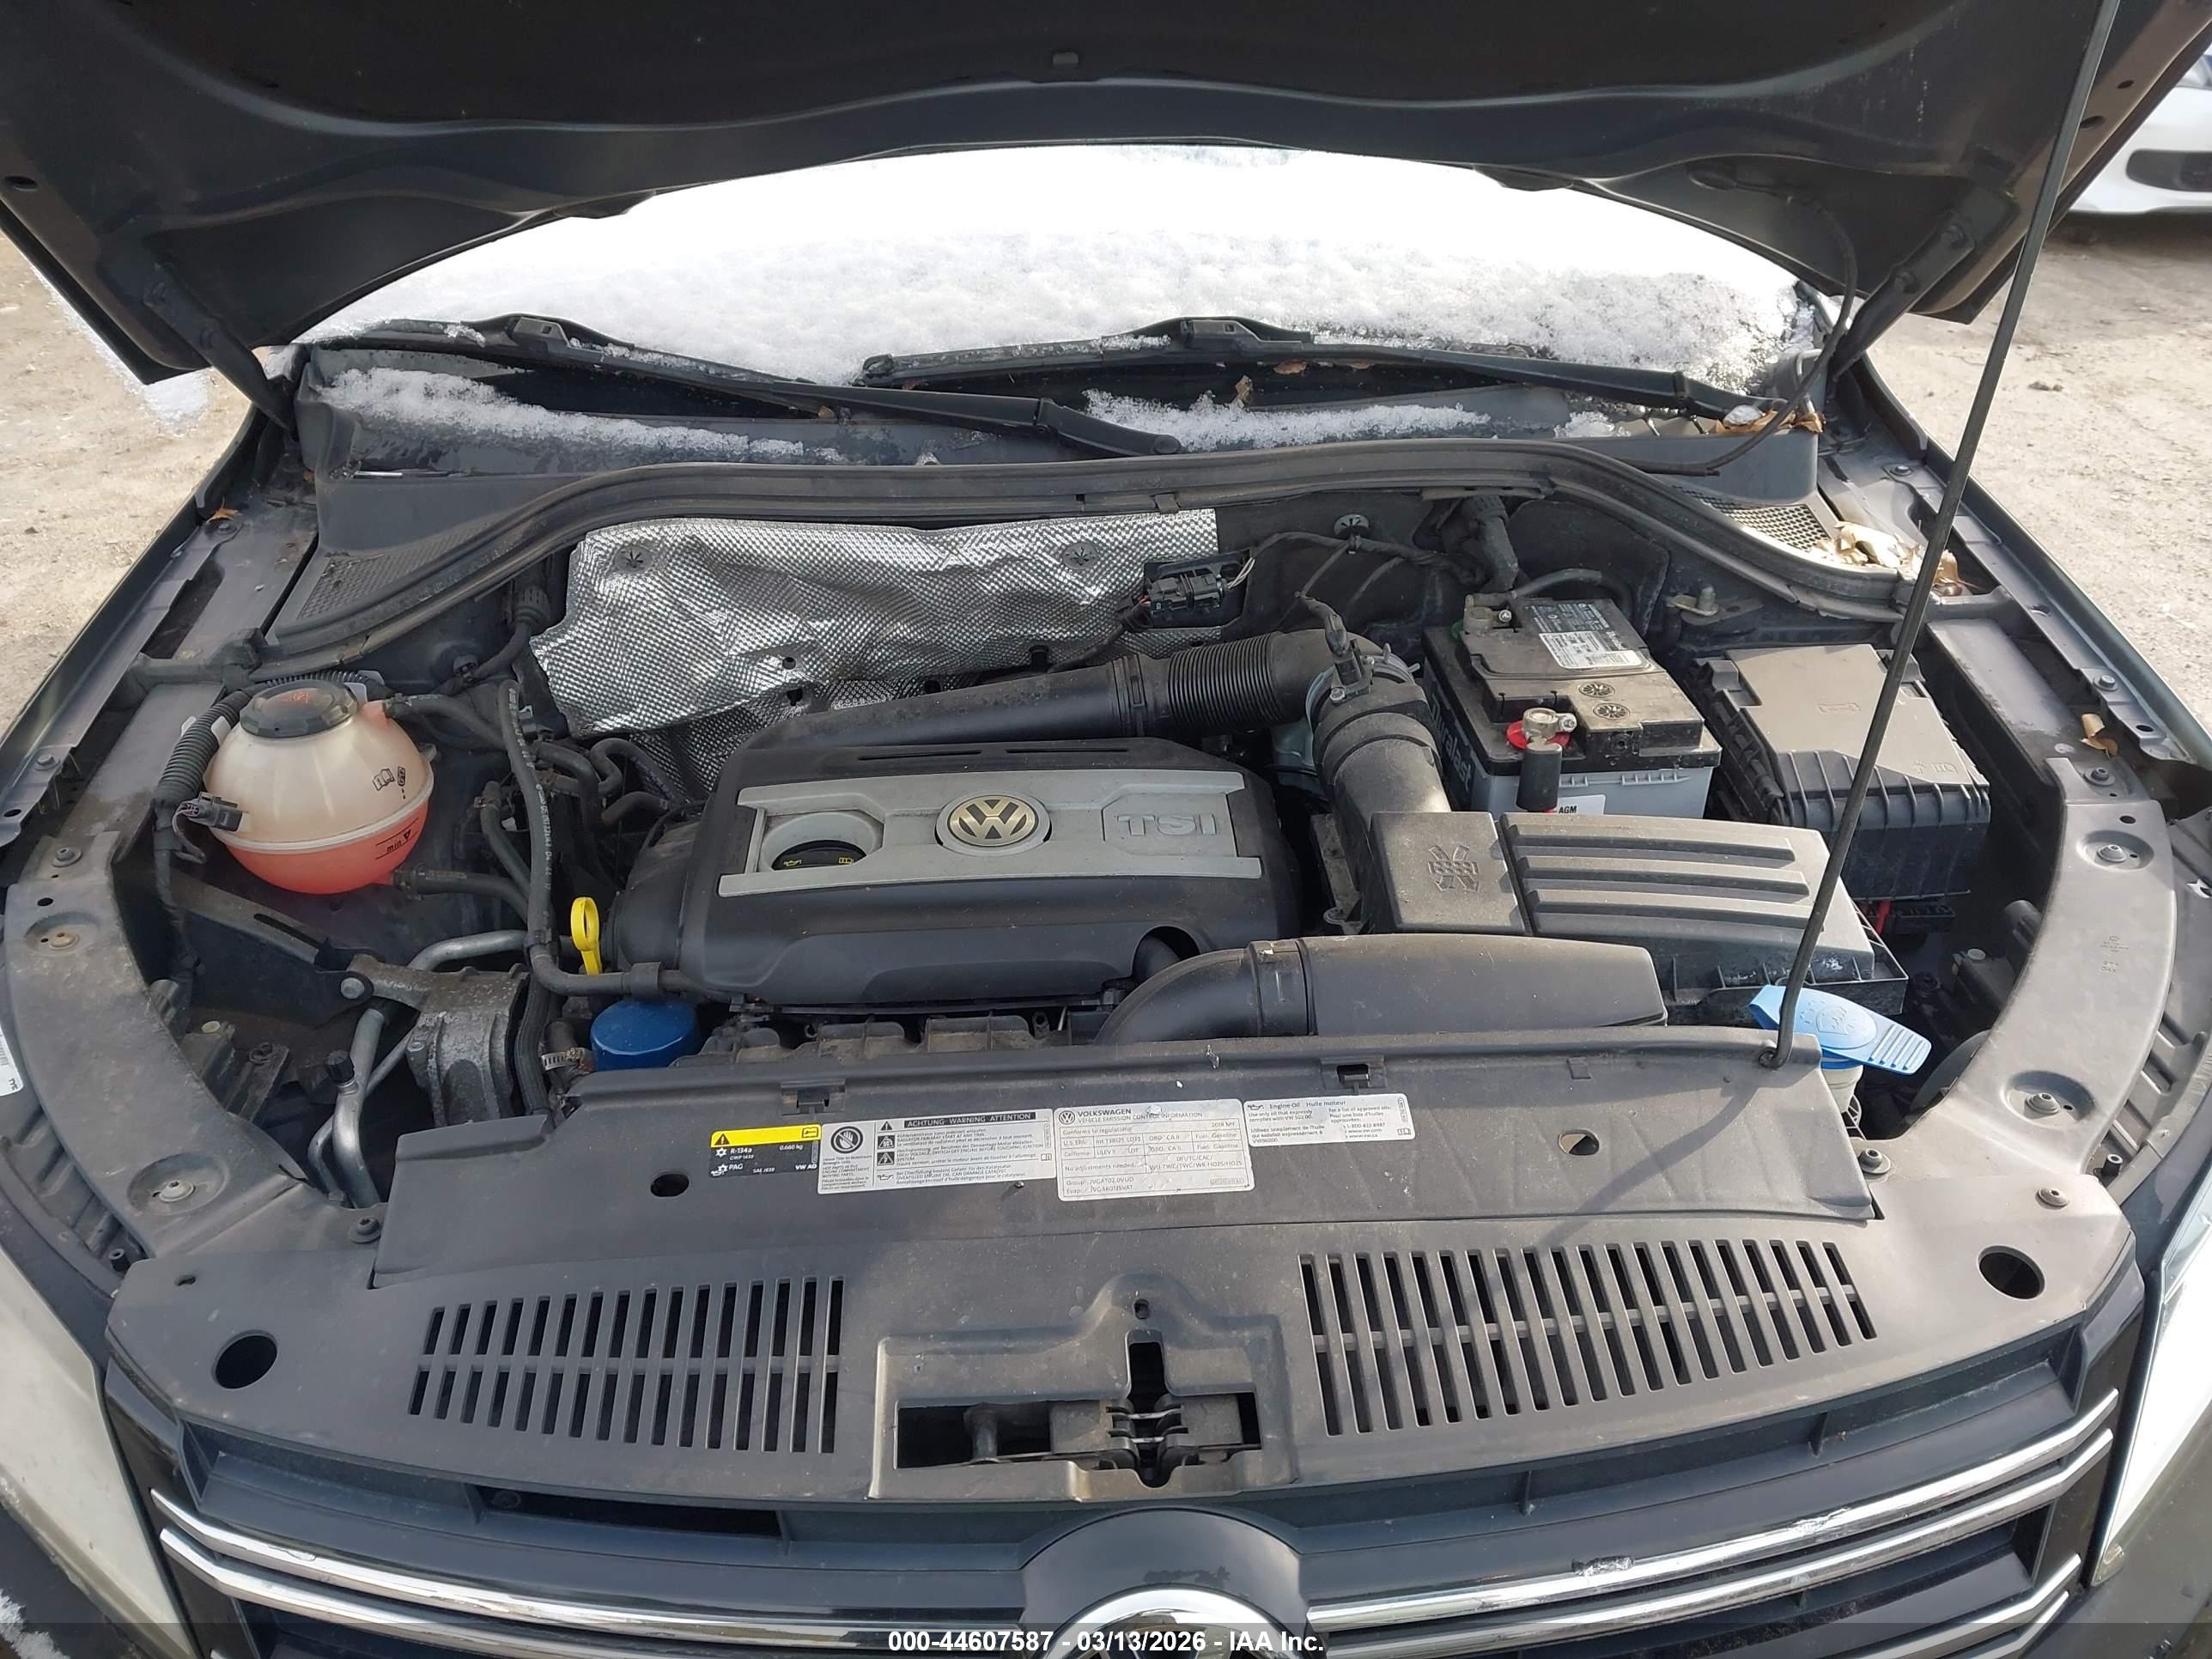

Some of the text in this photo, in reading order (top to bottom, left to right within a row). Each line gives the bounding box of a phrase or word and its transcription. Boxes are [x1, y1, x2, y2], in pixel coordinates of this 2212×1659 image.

[1559, 805, 1577, 814] AGM
[1116, 814, 1217, 836] TSI
[387, 841, 402, 854] min
[1078, 1108, 1131, 1117] VOLKSWAGEN
[907, 1113, 1031, 1127] ACHTUNG WARNING ATTENTION
